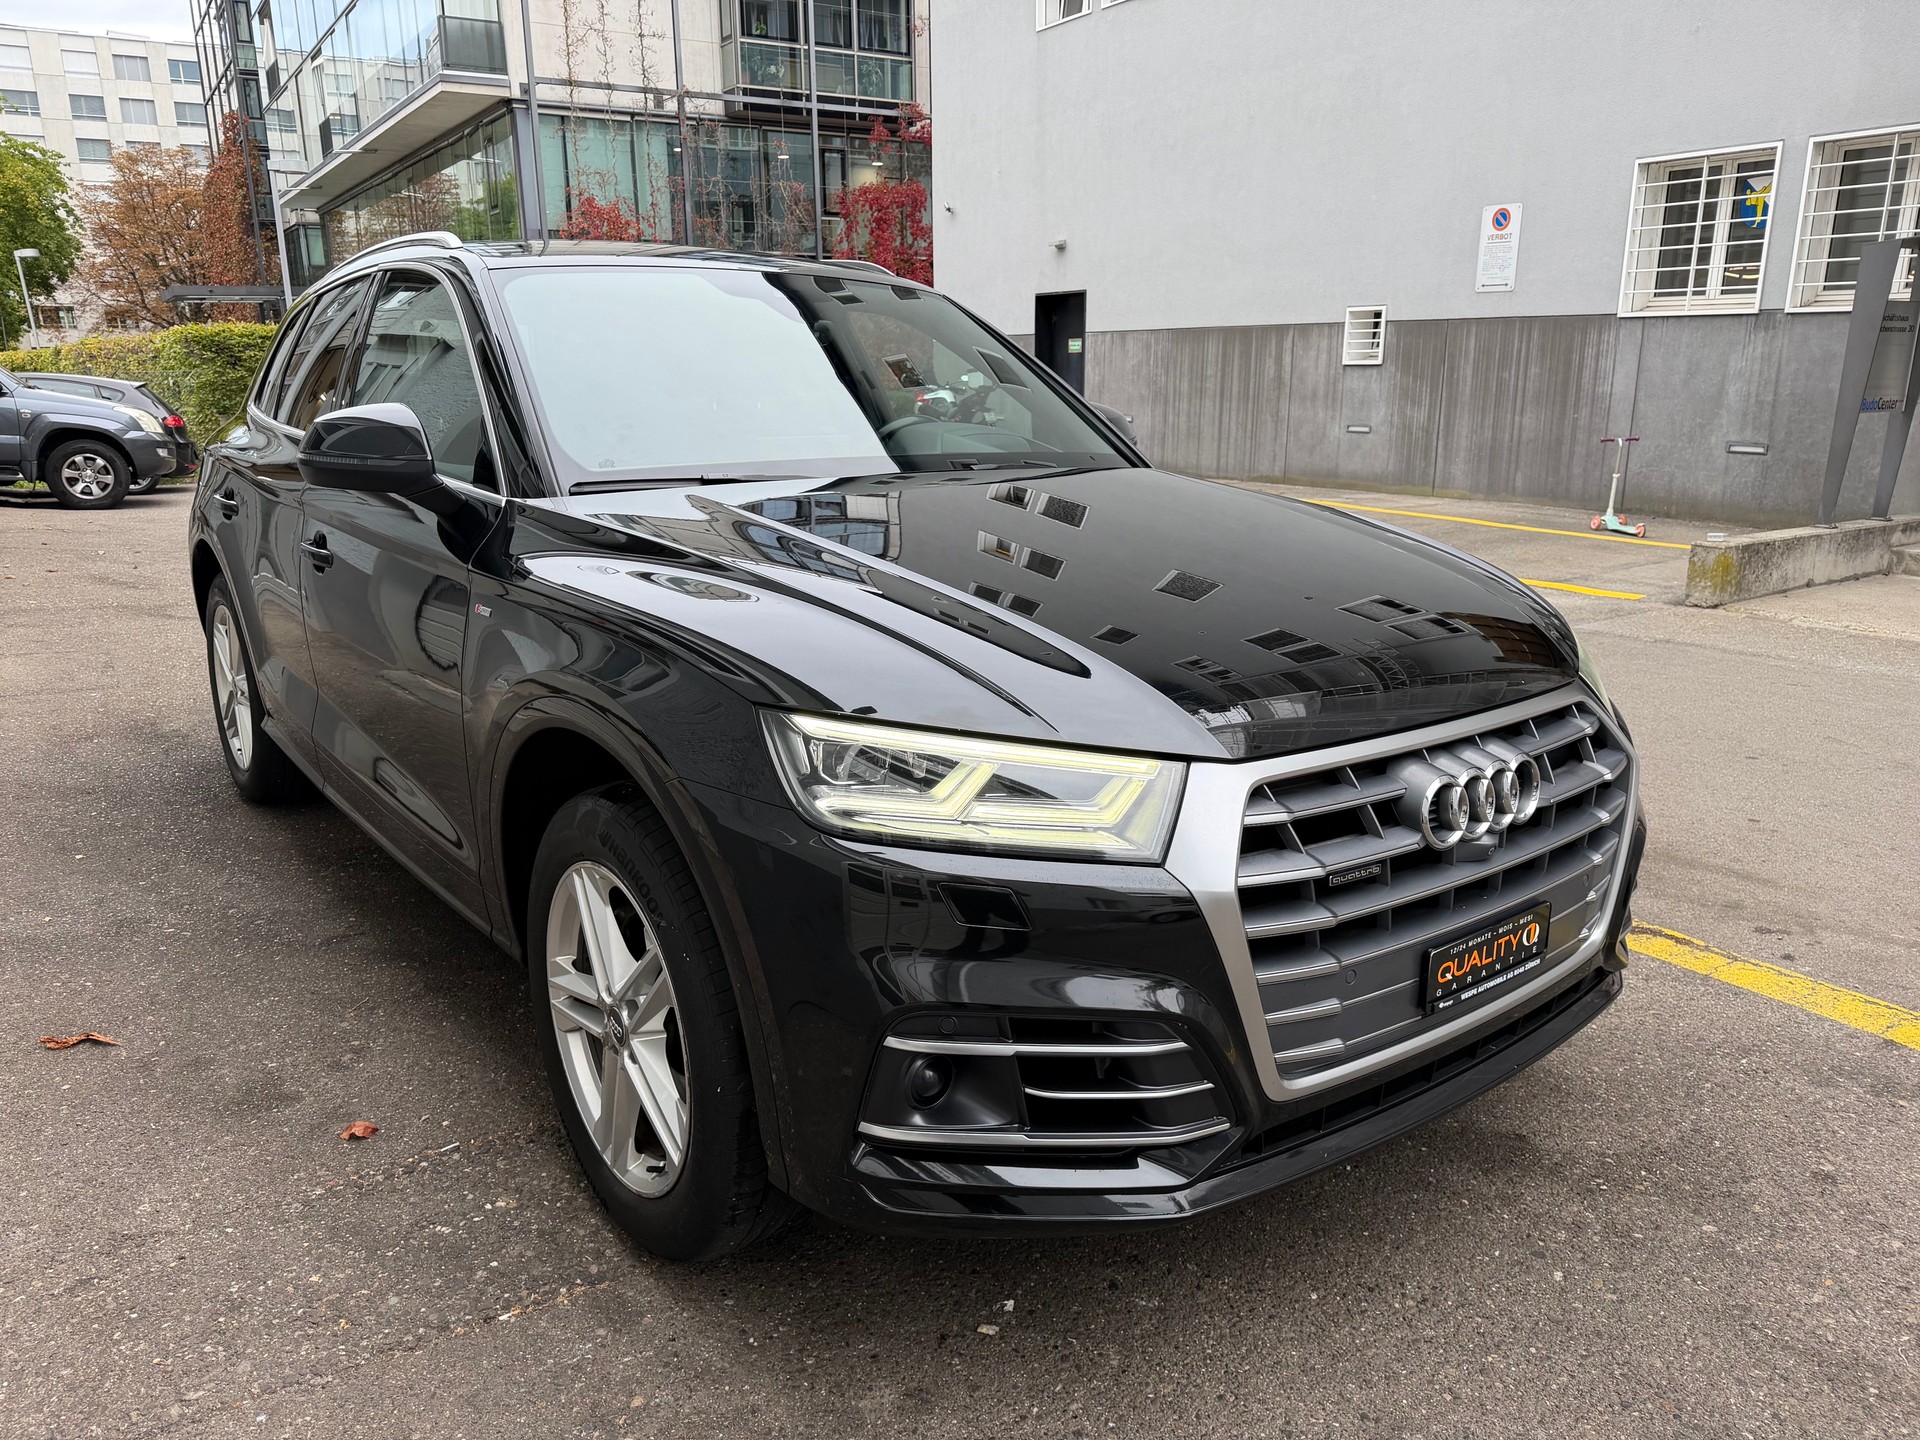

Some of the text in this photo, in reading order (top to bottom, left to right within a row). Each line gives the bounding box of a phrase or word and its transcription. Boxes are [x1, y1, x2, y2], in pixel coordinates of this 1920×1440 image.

[1487, 233, 1512, 241] VERBOT
[1332, 866, 1380, 884] quattro
[1450, 943, 1466, 955] 12/24
[1468, 932, 1492, 947] MONATE
[1499, 923, 1513, 934] MOIS
[1519, 914, 1534, 925] MESI
[1436, 945, 1537, 997] GARANTIE
[1460, 987, 1478, 1000] WESPE
[1477, 974, 1507, 993] AUTOMOBILE
